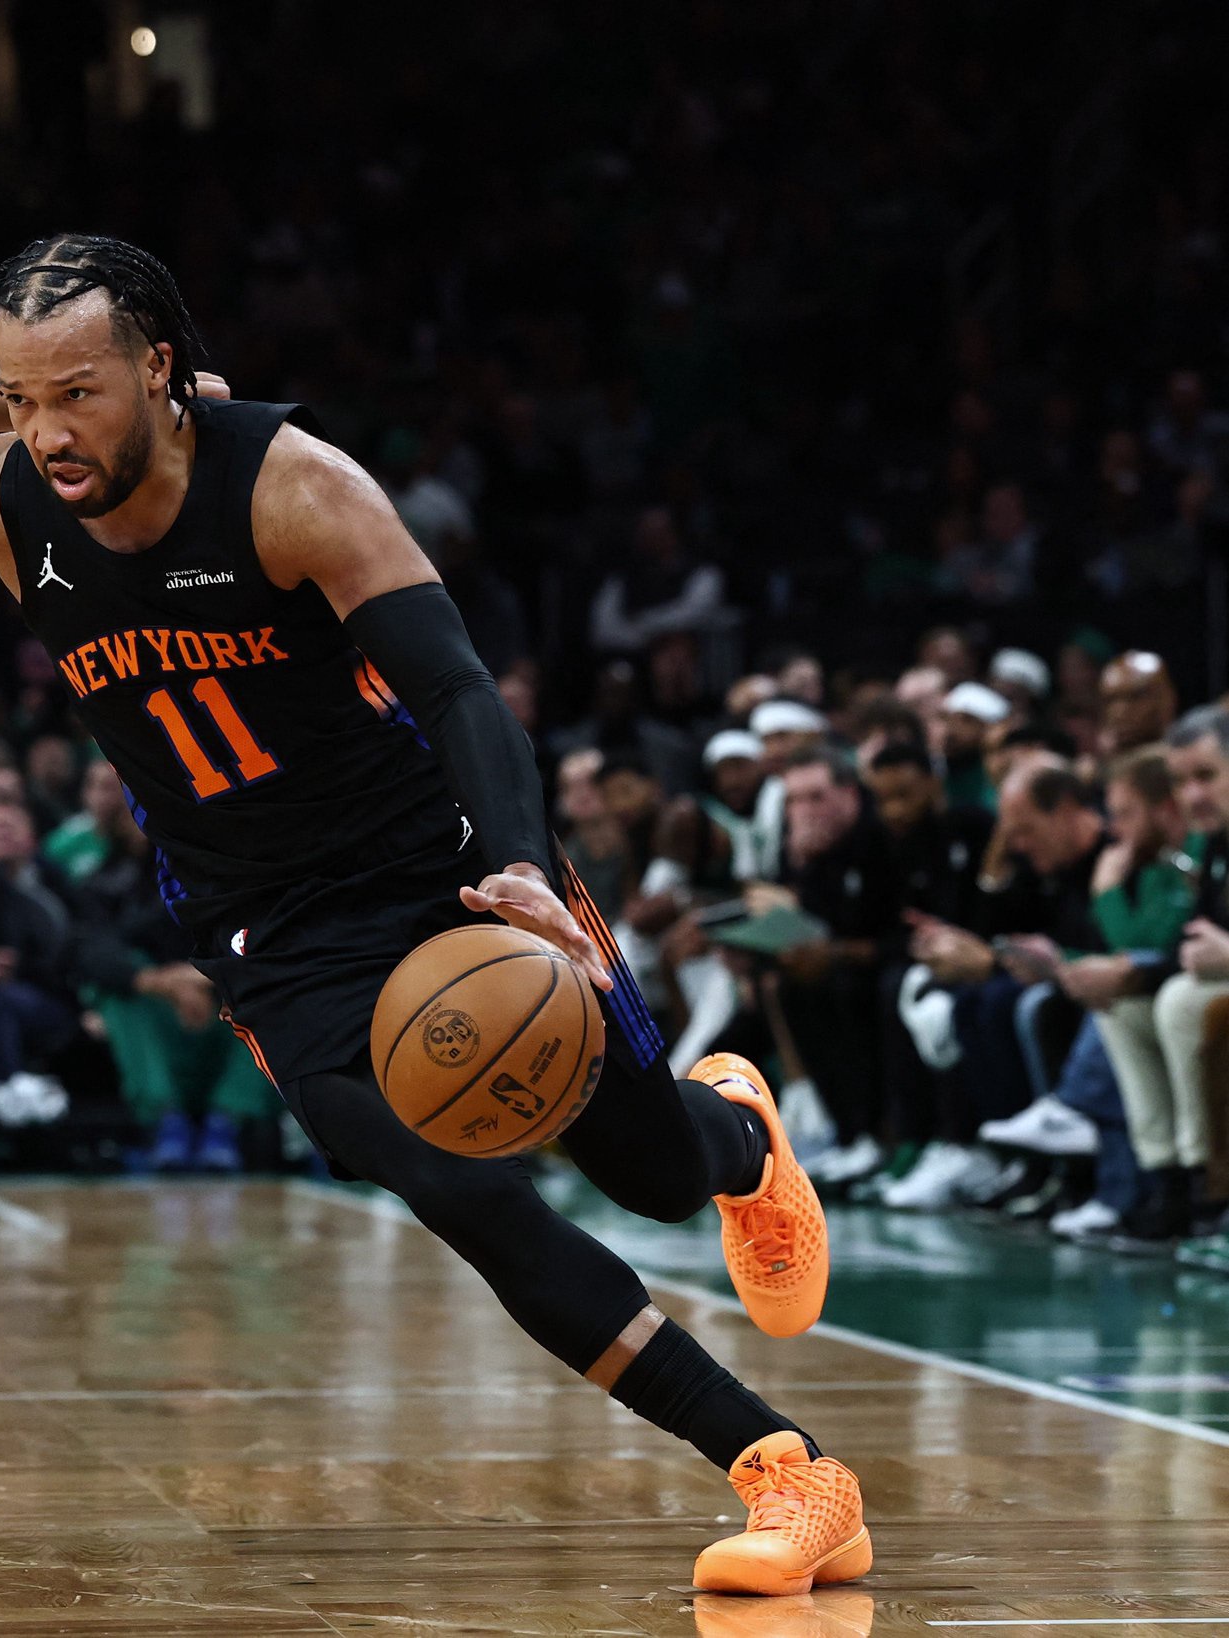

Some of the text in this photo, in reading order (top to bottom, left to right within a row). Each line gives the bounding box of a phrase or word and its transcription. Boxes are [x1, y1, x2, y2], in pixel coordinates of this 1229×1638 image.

[166, 570, 235, 590] abu dhabi
[58, 625, 289, 699] NEW YORK
[143, 675, 281, 802] 11
